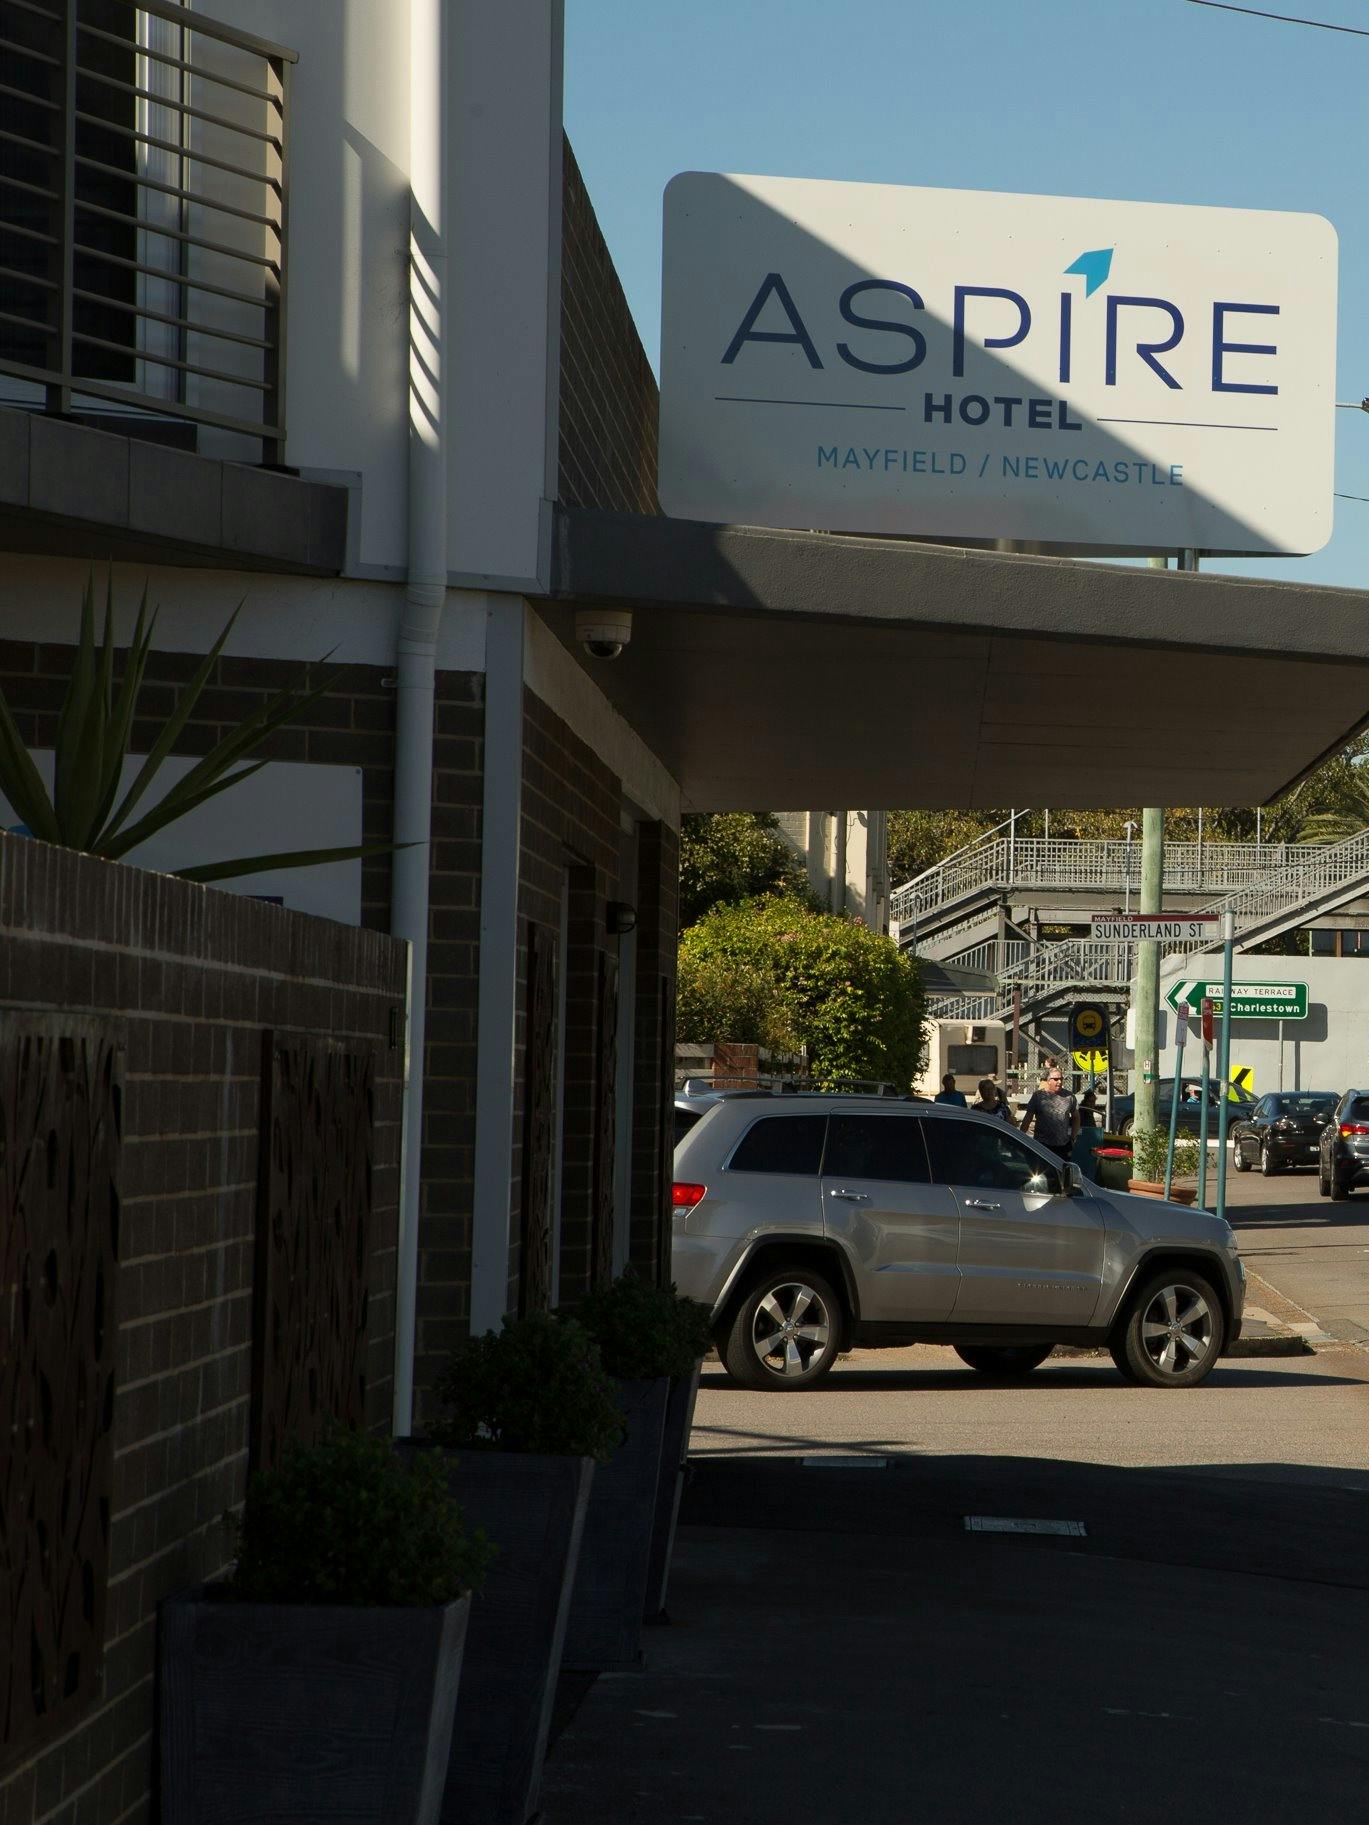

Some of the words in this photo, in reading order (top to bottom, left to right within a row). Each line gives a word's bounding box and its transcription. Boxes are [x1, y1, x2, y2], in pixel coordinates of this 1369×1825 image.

[720, 272, 1280, 395] ASPIRE
[924, 392, 1082, 430] HOTEL
[818, 446, 967, 475] MAYFIELD
[1002, 455, 1184, 486] NEWCASTLE
[1095, 923, 1181, 938] SUNDERLAND
[1189, 923, 1203, 937] ST
[1208, 987, 1249, 995] RAIWAY
[1254, 988, 1293, 996] TERRACE
[1230, 1002, 1300, 1013] Charlestown
